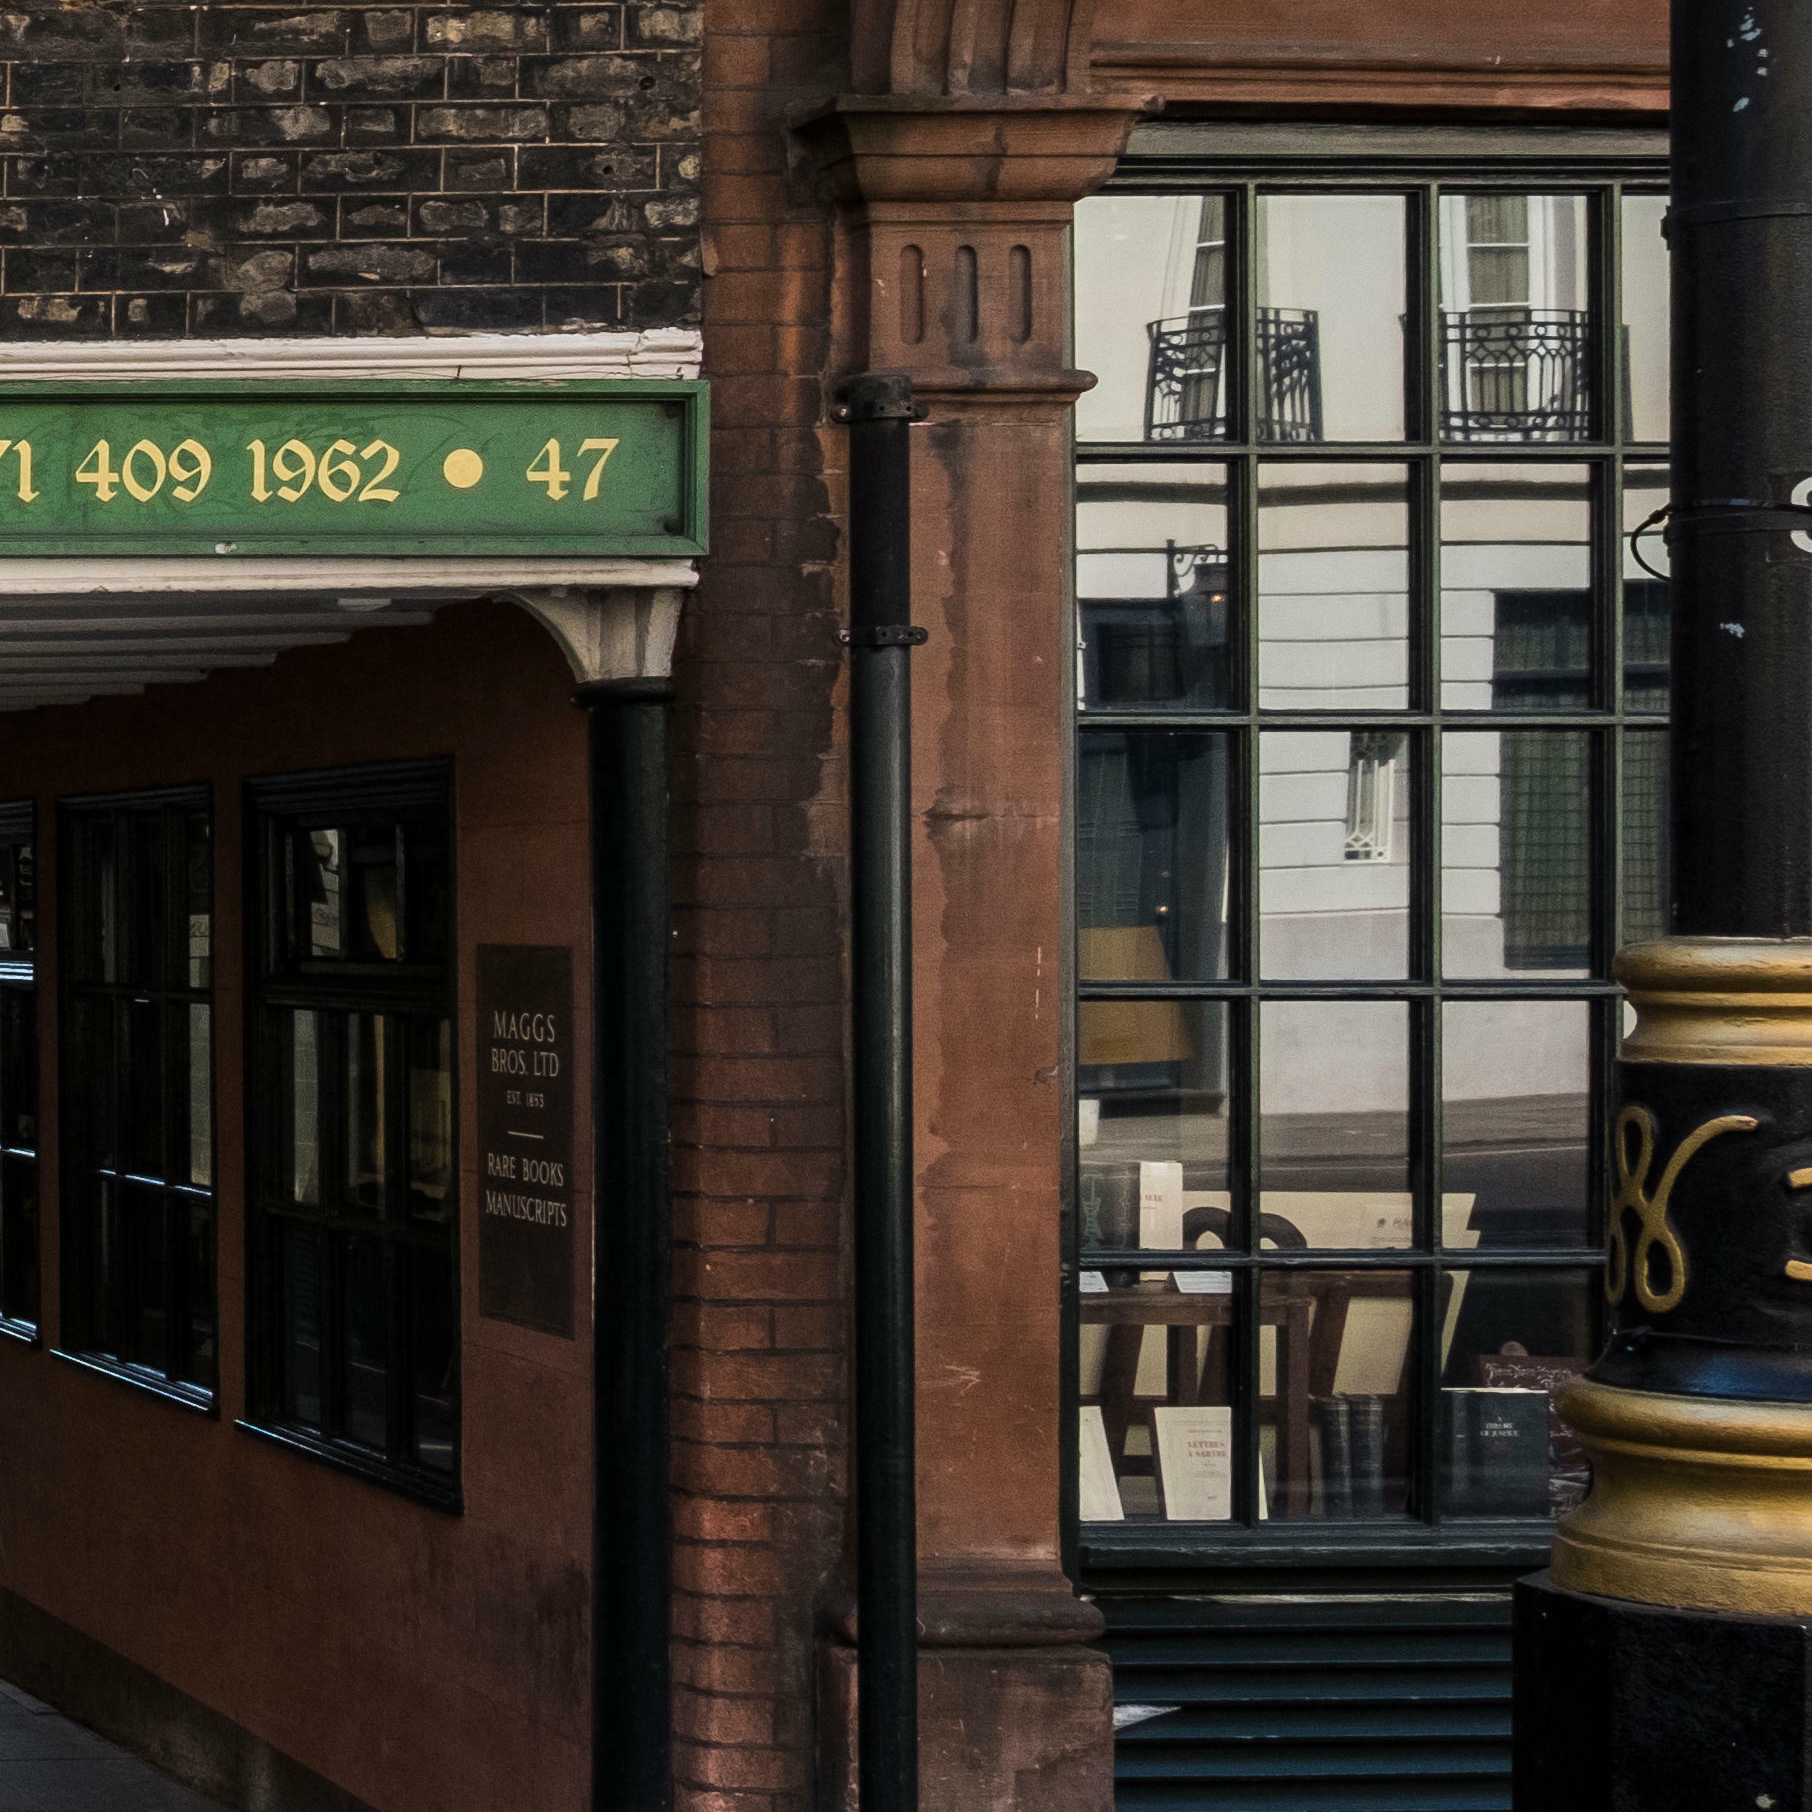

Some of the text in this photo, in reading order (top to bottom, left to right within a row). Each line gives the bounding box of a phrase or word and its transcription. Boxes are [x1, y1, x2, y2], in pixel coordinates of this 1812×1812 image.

[75, 437, 213, 504] 409
[247, 437, 401, 504] 1962
[525, 437, 620, 502] 47
[493, 1010, 556, 1043] MAGGS
[491, 1047, 560, 1078] BROS. LTD
[487, 1152, 565, 1188] RARE BOOKS
[485, 1190, 567, 1228] MANUSCRIPTS
